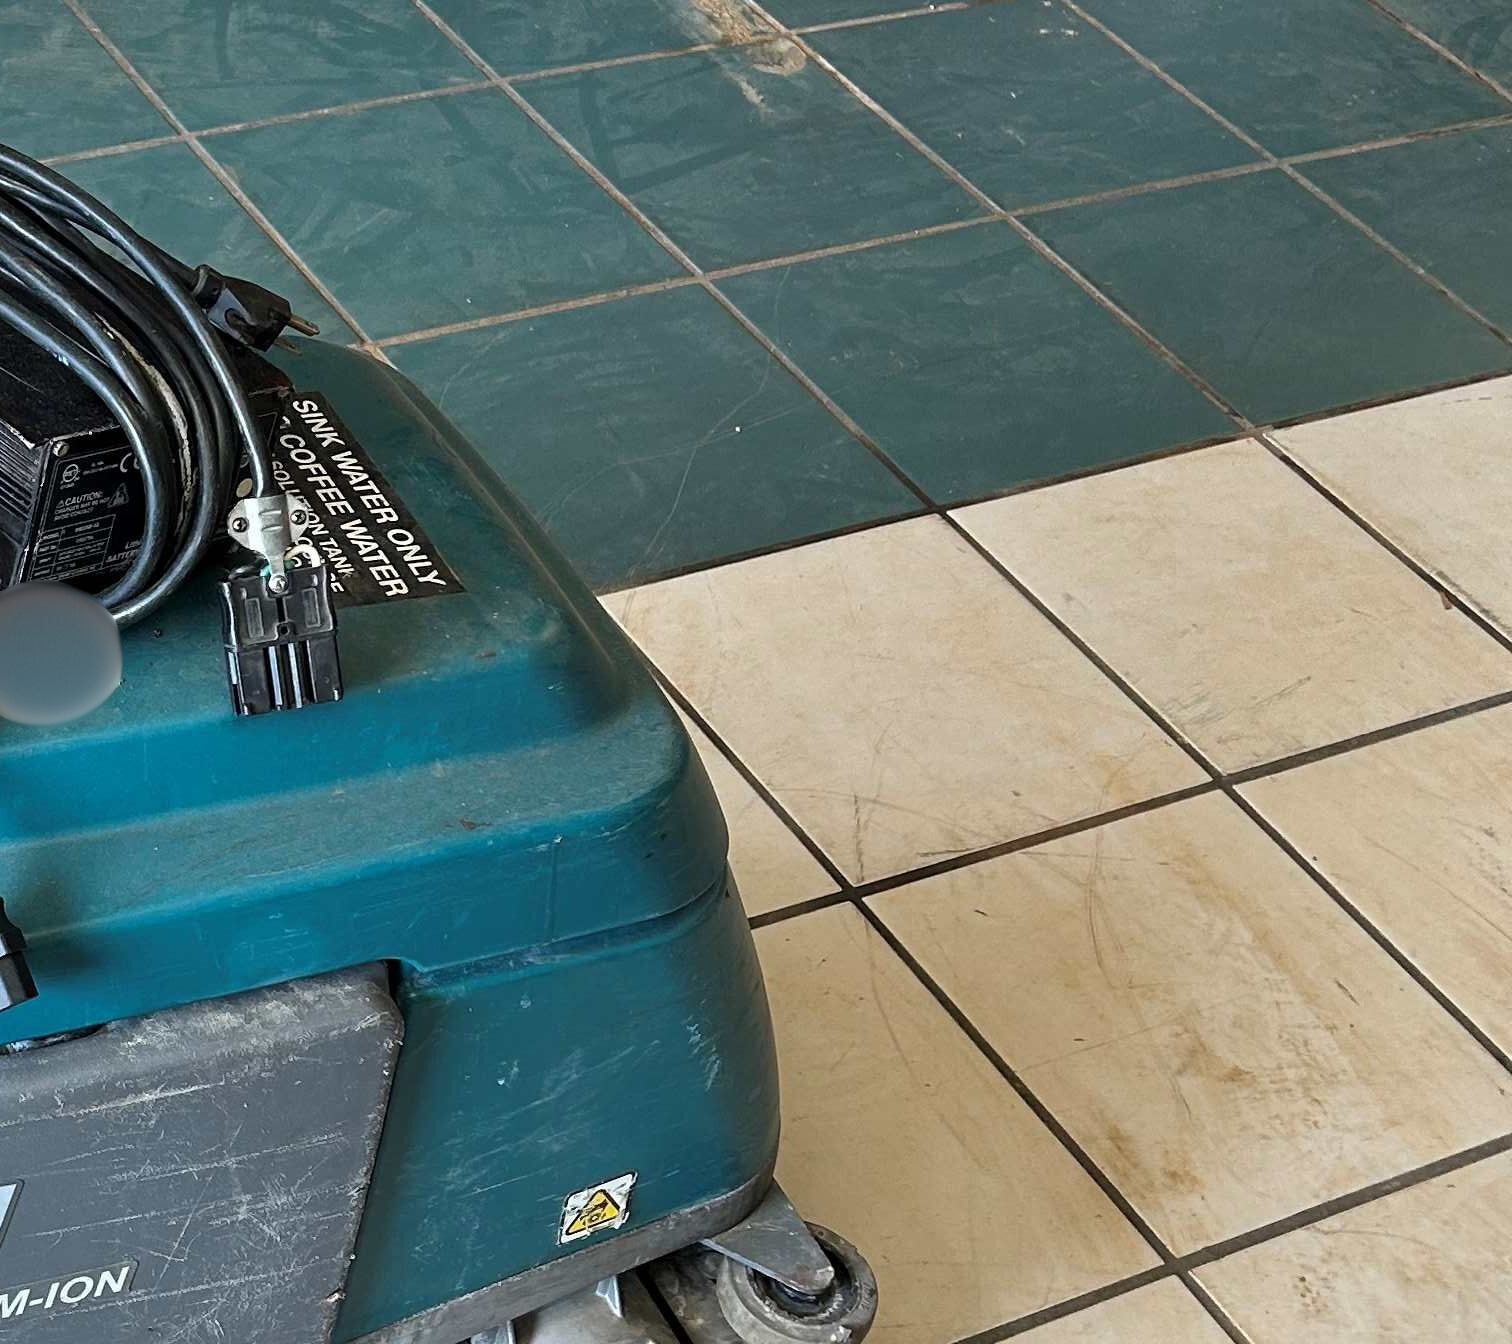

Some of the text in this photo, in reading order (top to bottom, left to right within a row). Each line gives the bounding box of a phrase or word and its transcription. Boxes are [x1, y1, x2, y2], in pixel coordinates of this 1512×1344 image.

[271, 460, 330, 536] SOLUON
[318, 537, 355, 579] TANK
[279, 434, 355, 516] COFFEE
[339, 518, 410, 598] WATER
[292, 399, 447, 588] SINK WATER ONLY
